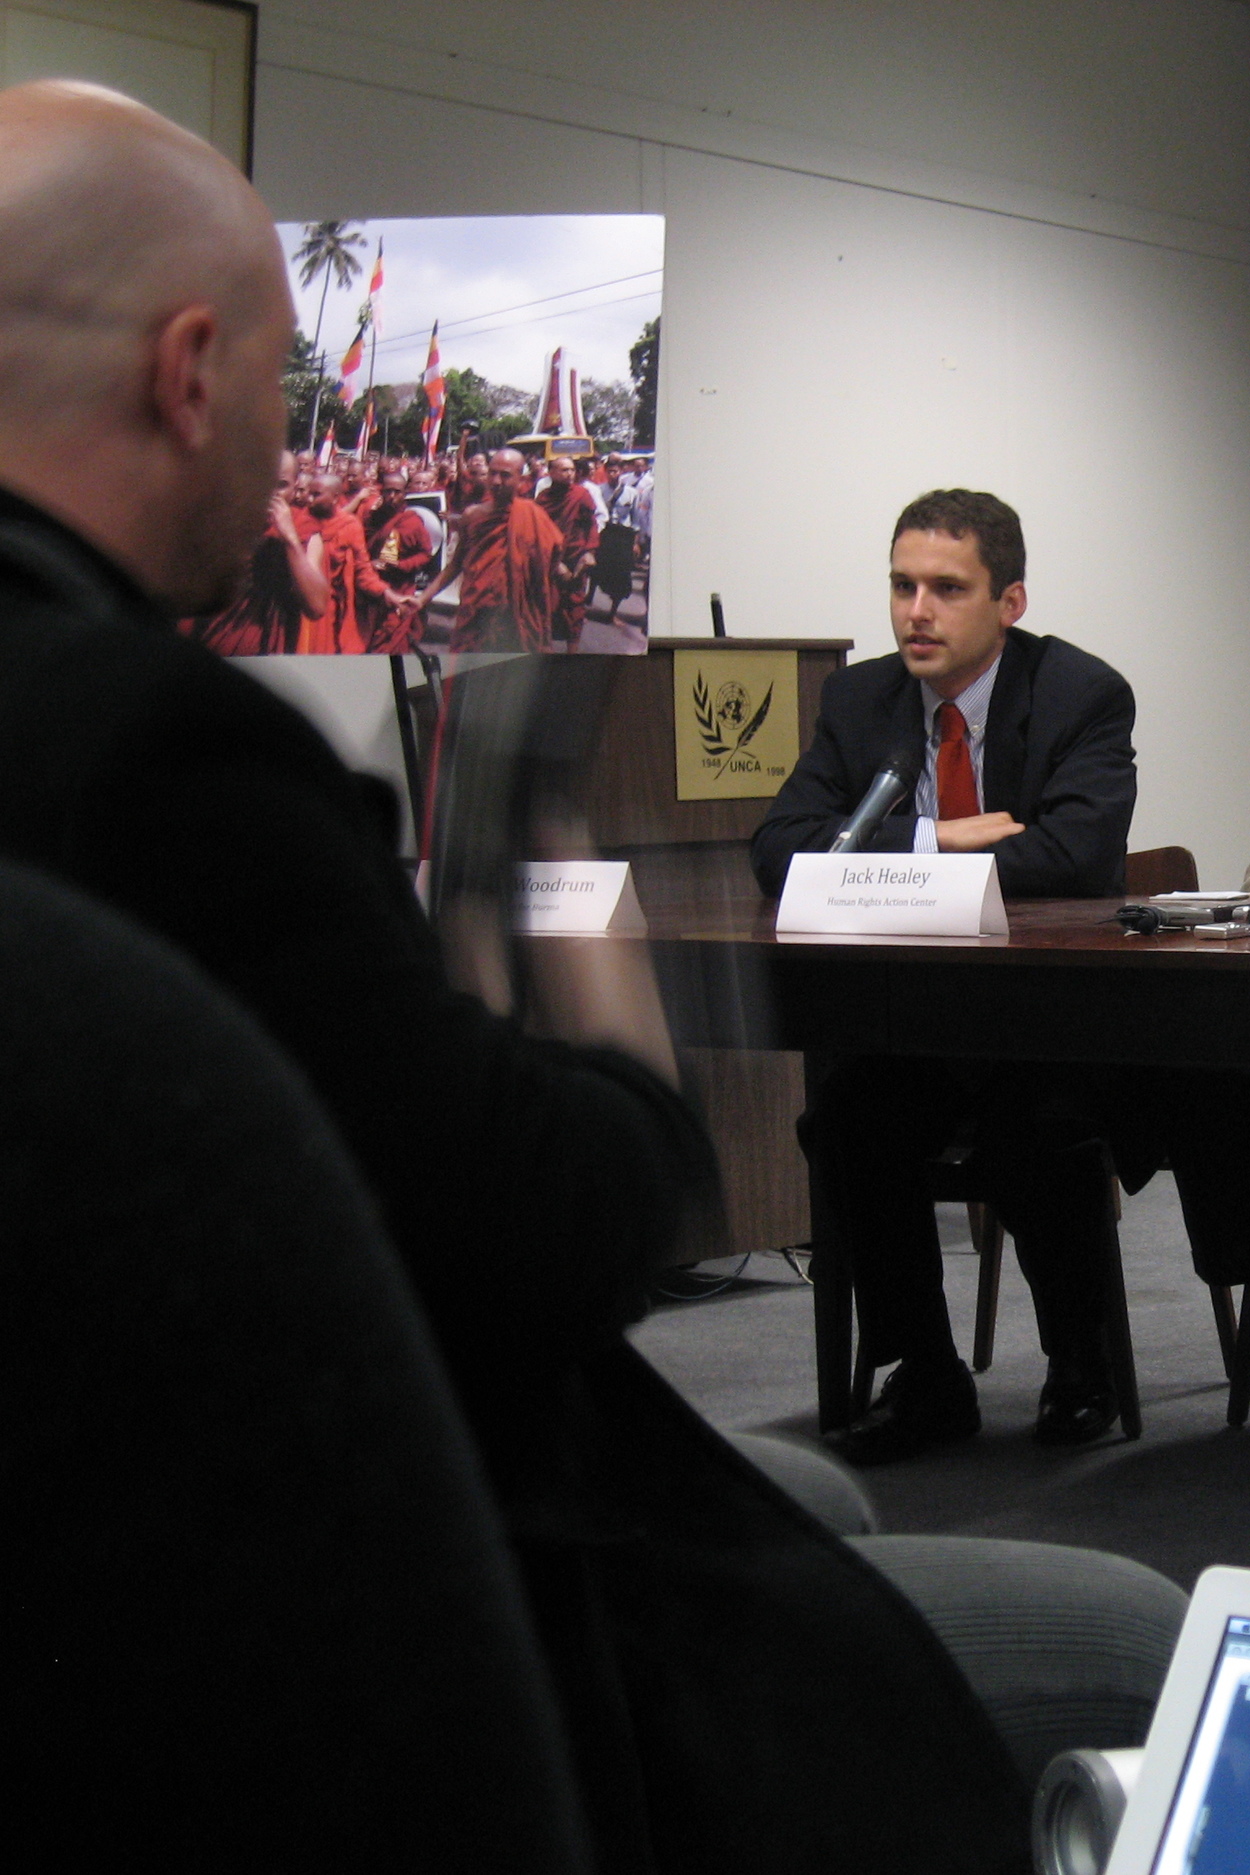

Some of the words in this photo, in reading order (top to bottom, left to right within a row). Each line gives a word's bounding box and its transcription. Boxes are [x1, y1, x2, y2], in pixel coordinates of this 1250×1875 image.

[730, 761, 761, 773] UNCA
[840, 867, 875, 888] Jack
[877, 867, 932, 889] Healey
[827, 897, 856, 907] Human
[857, 897, 882, 909] Rights
[883, 897, 909, 907] Action
[910, 897, 938, 907] Center
